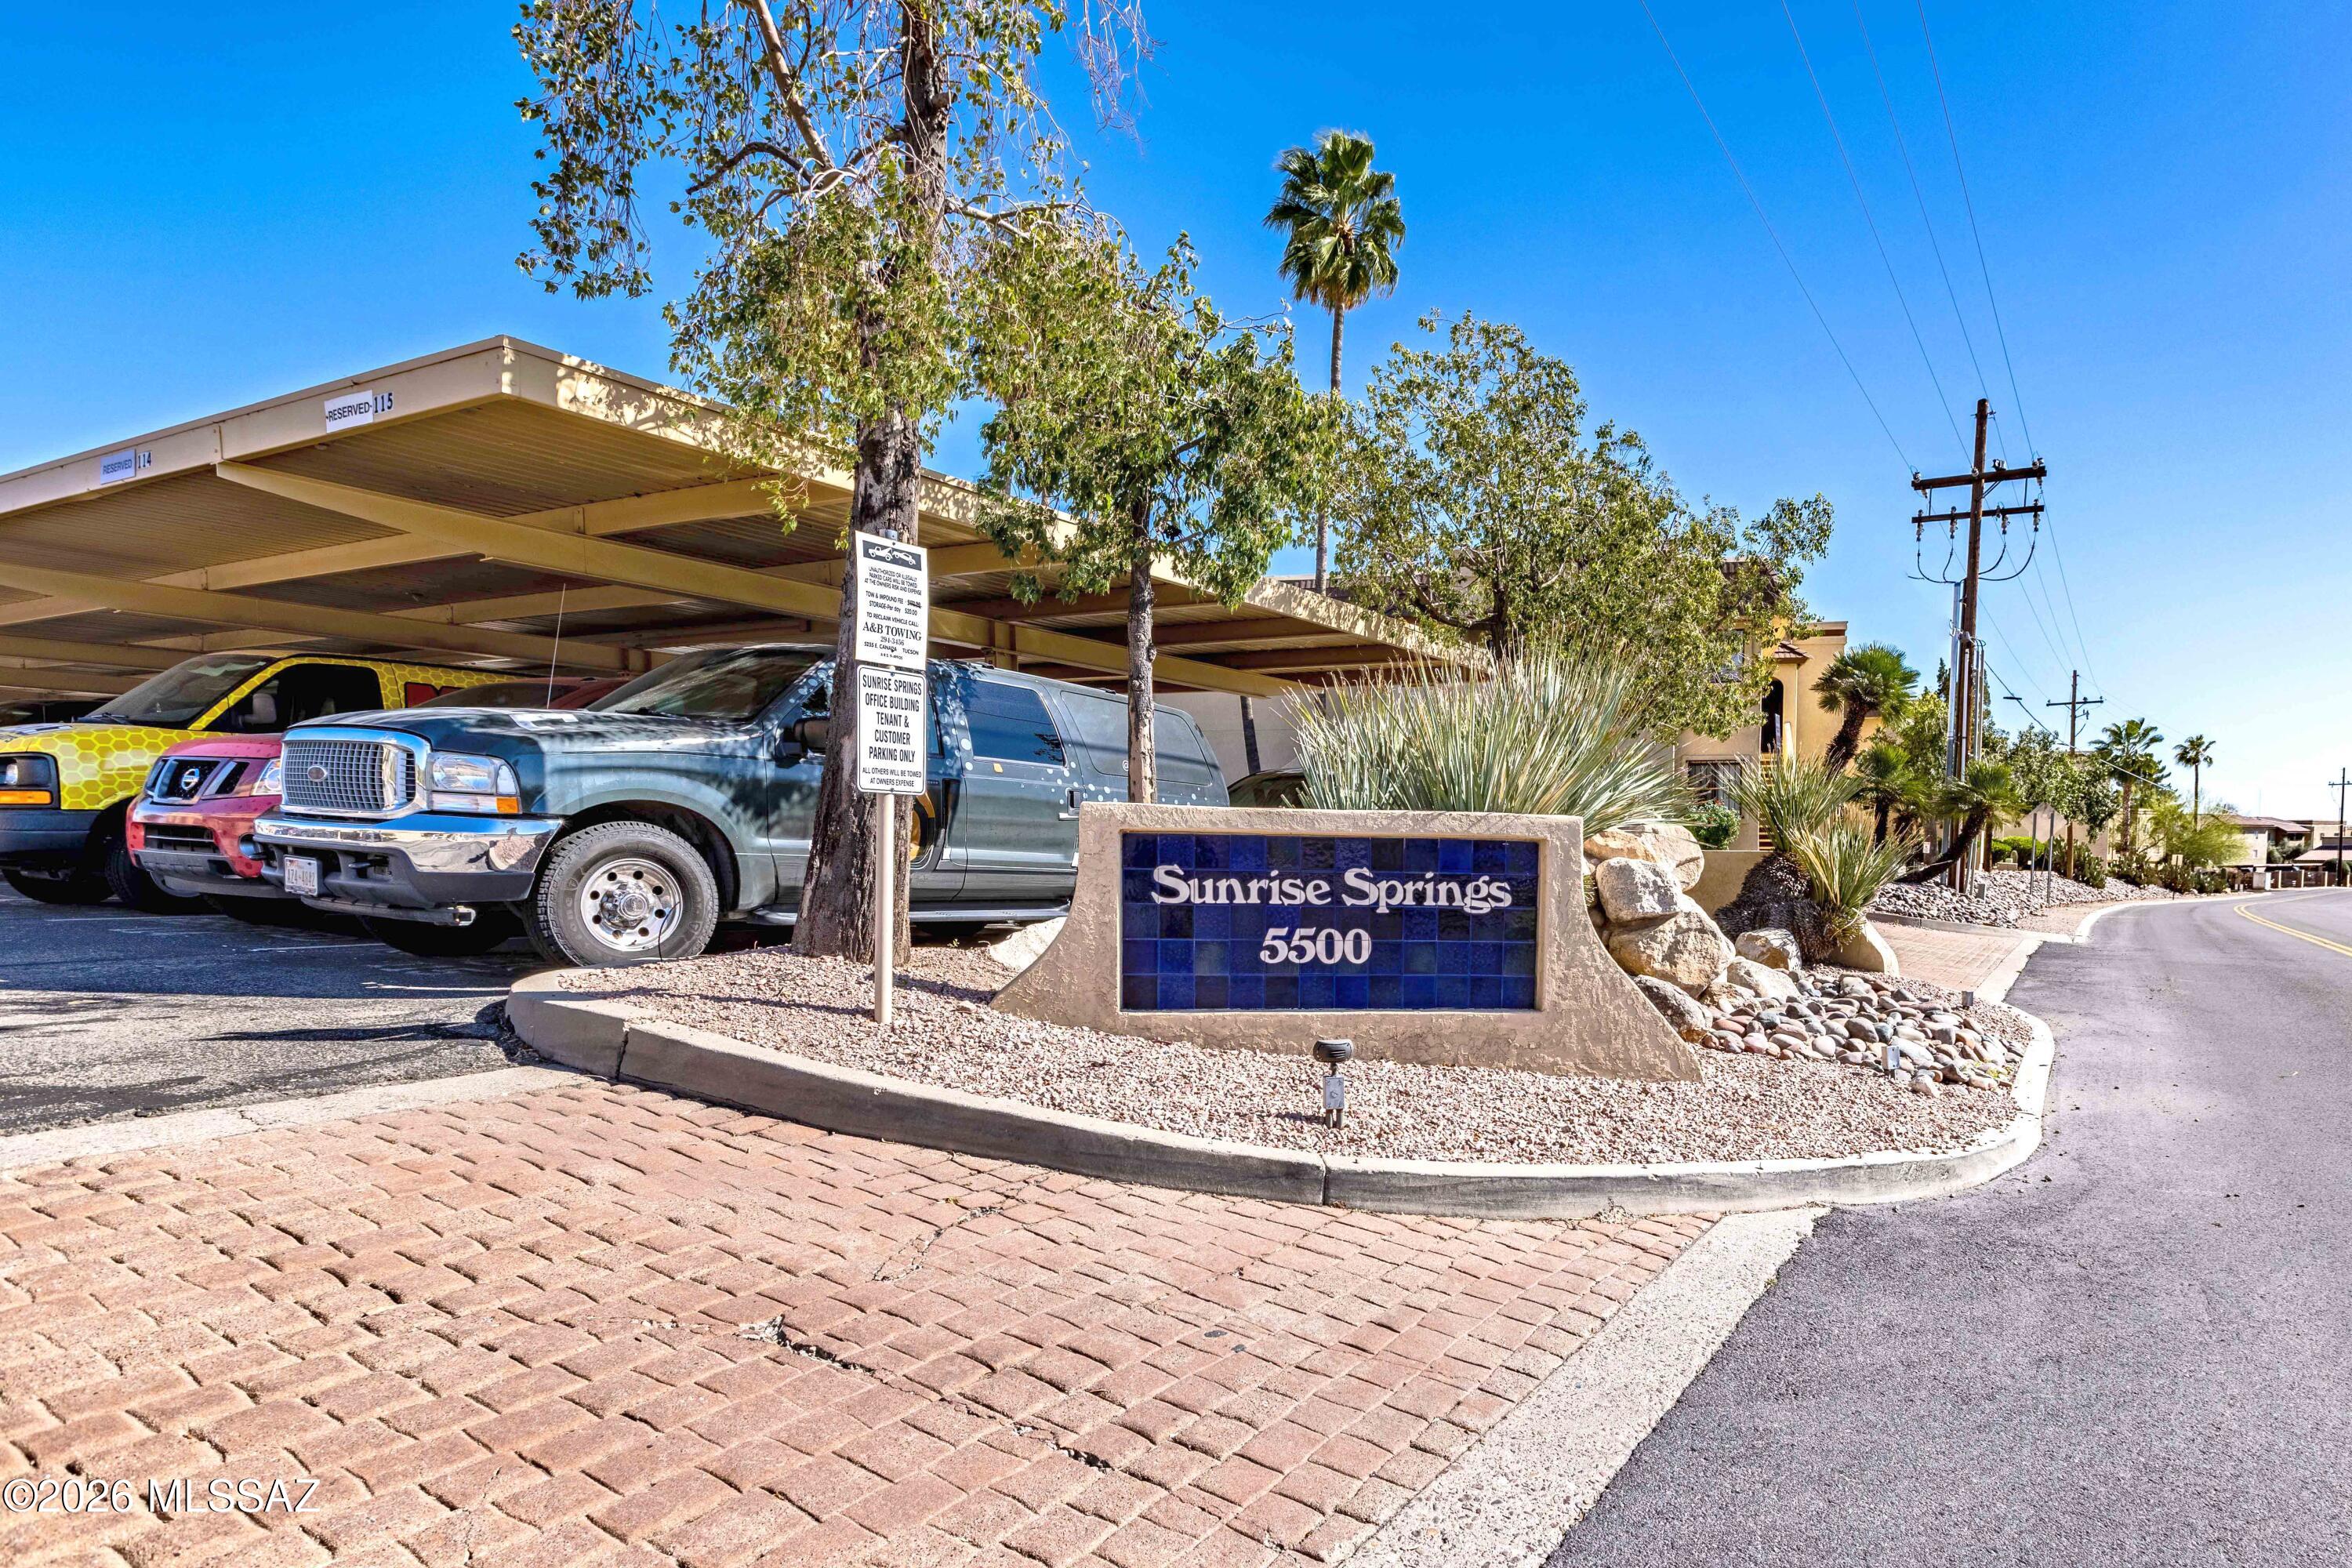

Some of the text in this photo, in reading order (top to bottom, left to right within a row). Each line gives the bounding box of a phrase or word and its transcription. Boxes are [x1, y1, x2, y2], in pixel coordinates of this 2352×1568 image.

[328, 392, 393, 422] RESERVED 115
[103, 452, 151, 475] RESERVED 114
[869, 566, 895, 577] UNAUTHORIZED
[880, 593, 897, 603] IMPOUND
[908, 587, 922, 596] EXPENSE
[873, 613, 891, 622] RECLAIM
[891, 617, 908, 626] VEHICLE
[862, 621, 922, 641] A&B TOWING
[879, 644, 897, 653] CANADA
[862, 674, 922, 695] SUNRISE SPRINGS
[865, 692, 920, 712] OFFICE BUILDING
[876, 711, 909, 728] TENANT &
[874, 729, 911, 746] CUSTOMER
[869, 746, 916, 763] PARKING ONLY
[895, 779, 915, 787] EXPENSE
[1151, 864, 1512, 914] Sunrise Springs
[1259, 927, 1372, 965] 5500
